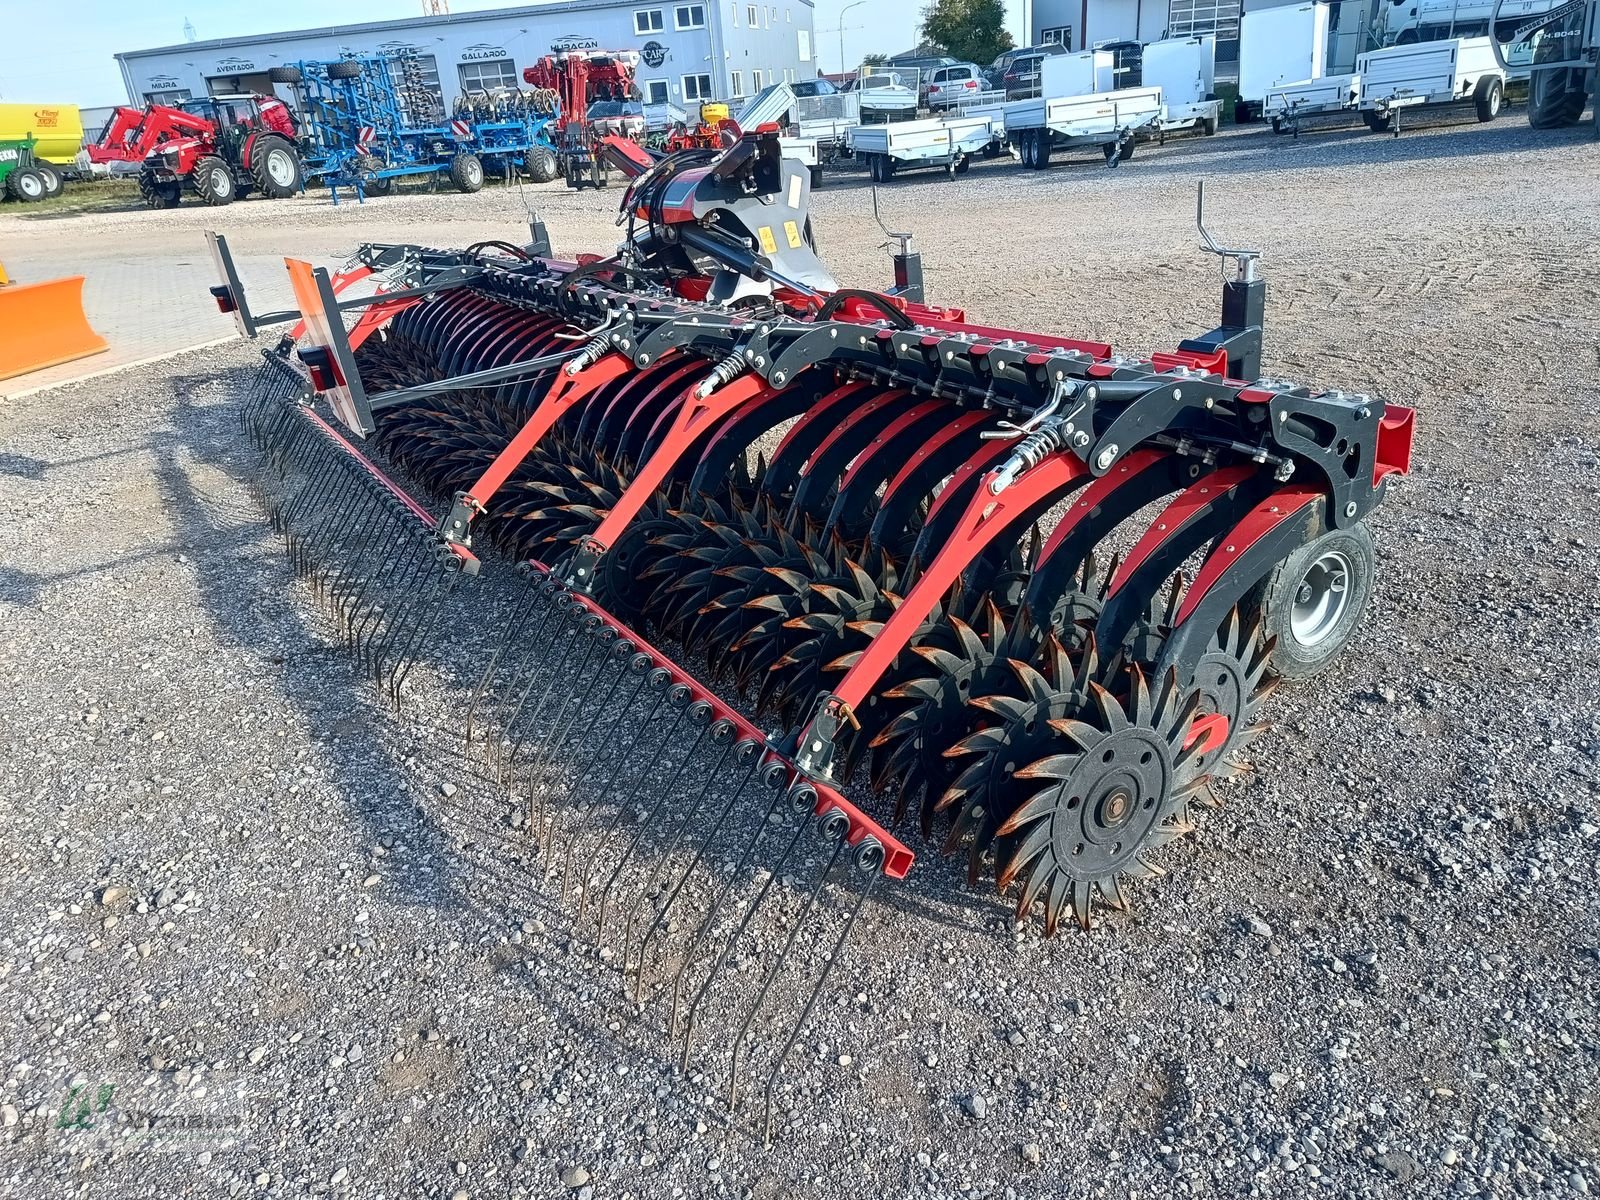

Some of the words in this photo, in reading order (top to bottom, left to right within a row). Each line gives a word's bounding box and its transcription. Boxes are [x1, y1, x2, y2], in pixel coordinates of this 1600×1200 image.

[1517, 18, 1545, 35] MASSEY
[1547, 1, 1585, 20] FERGUSON
[550, 41, 598, 51] HURACAN
[461, 50, 507, 60] GALLARDO
[645, 49, 662, 60] CAR
[216, 63, 255, 73] AVENTADOR
[151, 81, 177, 89] MIURA
